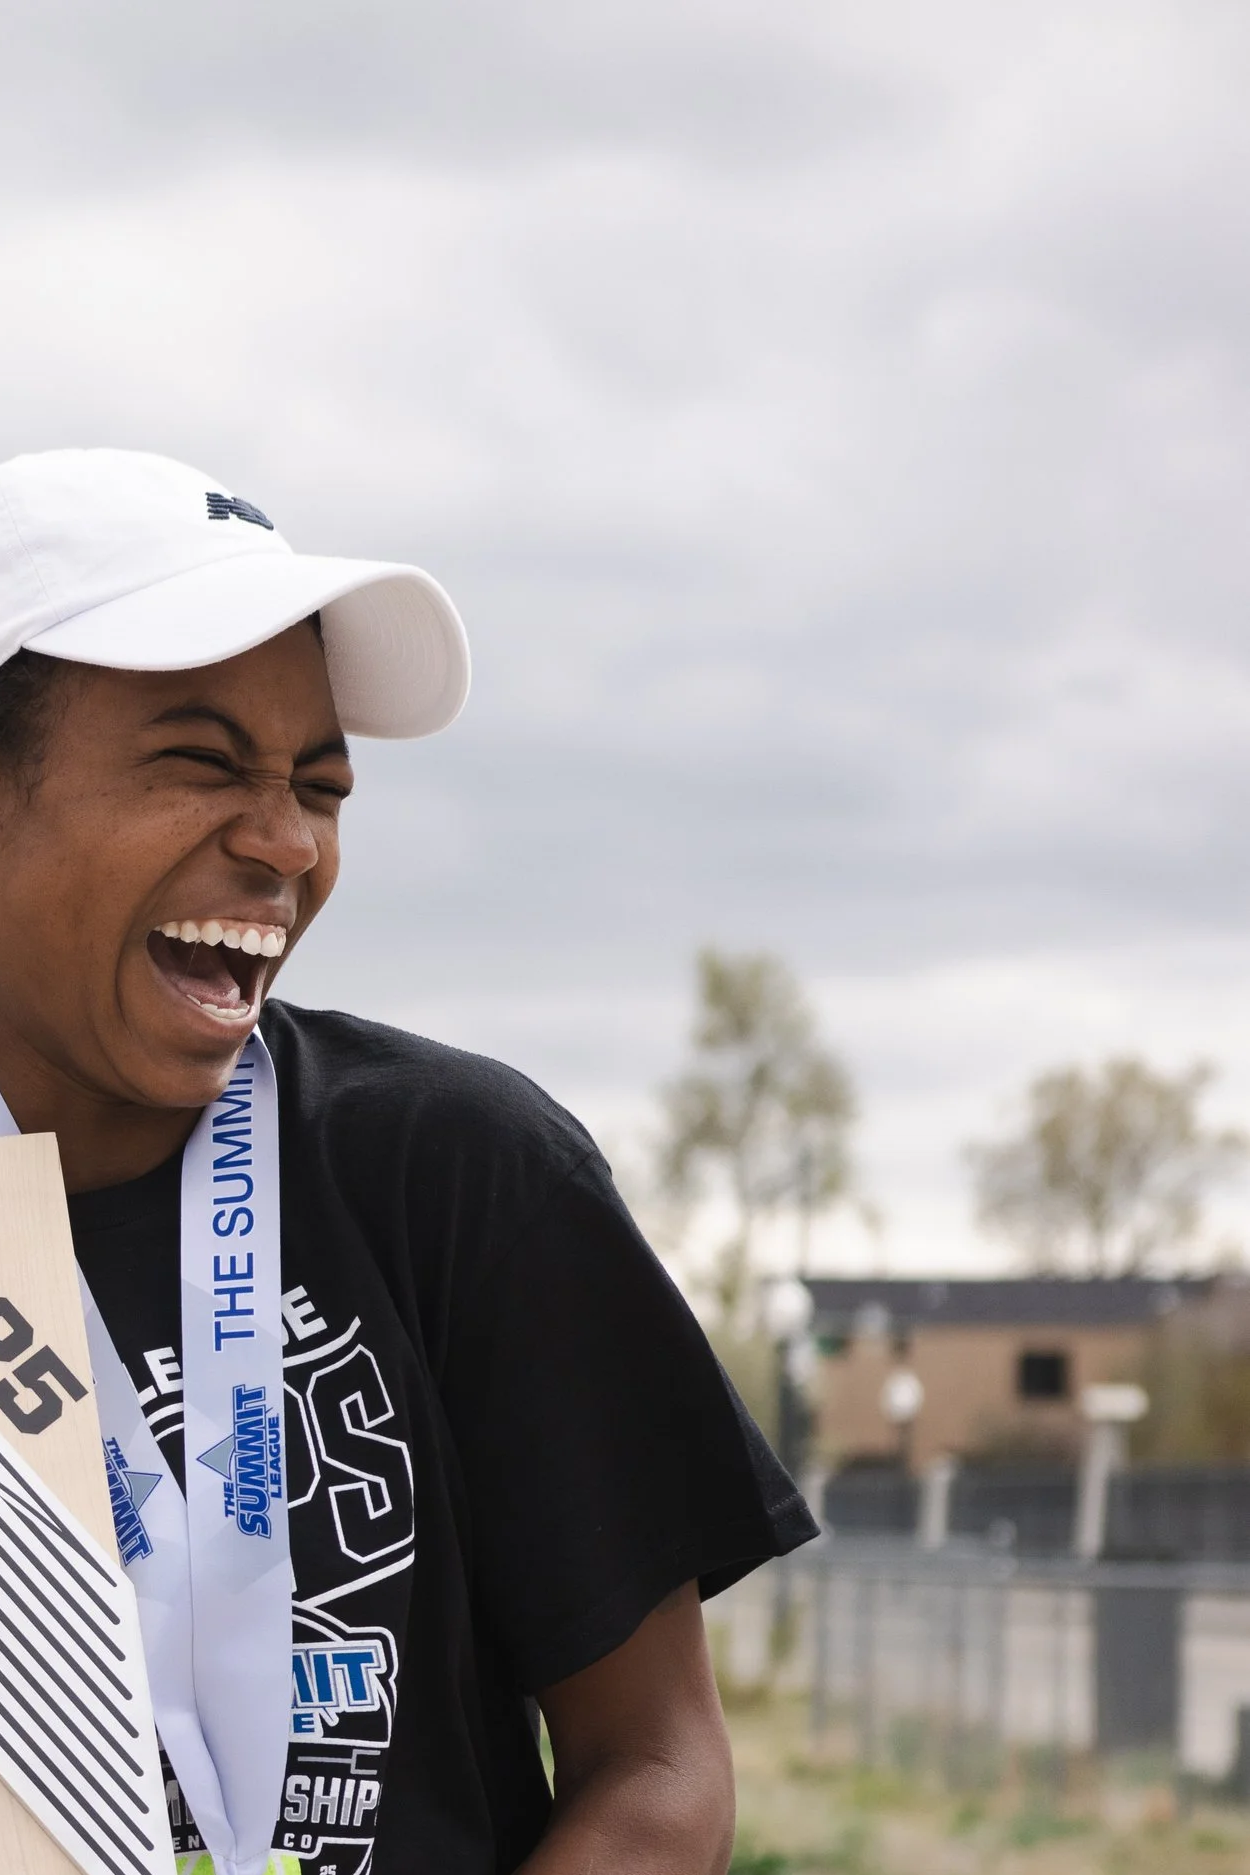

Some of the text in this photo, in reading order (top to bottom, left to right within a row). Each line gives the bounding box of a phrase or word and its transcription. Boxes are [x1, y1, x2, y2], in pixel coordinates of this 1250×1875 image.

[213, 1252, 255, 1352] THE
[105, 1436, 129, 1472] THE
[232, 1383, 272, 1539] SUMMIT
[268, 1415, 283, 1499] LEAGUE
[223, 1481, 237, 1518] THE
[284, 1774, 382, 1828] SHIP
[283, 1833, 312, 1849] CO
